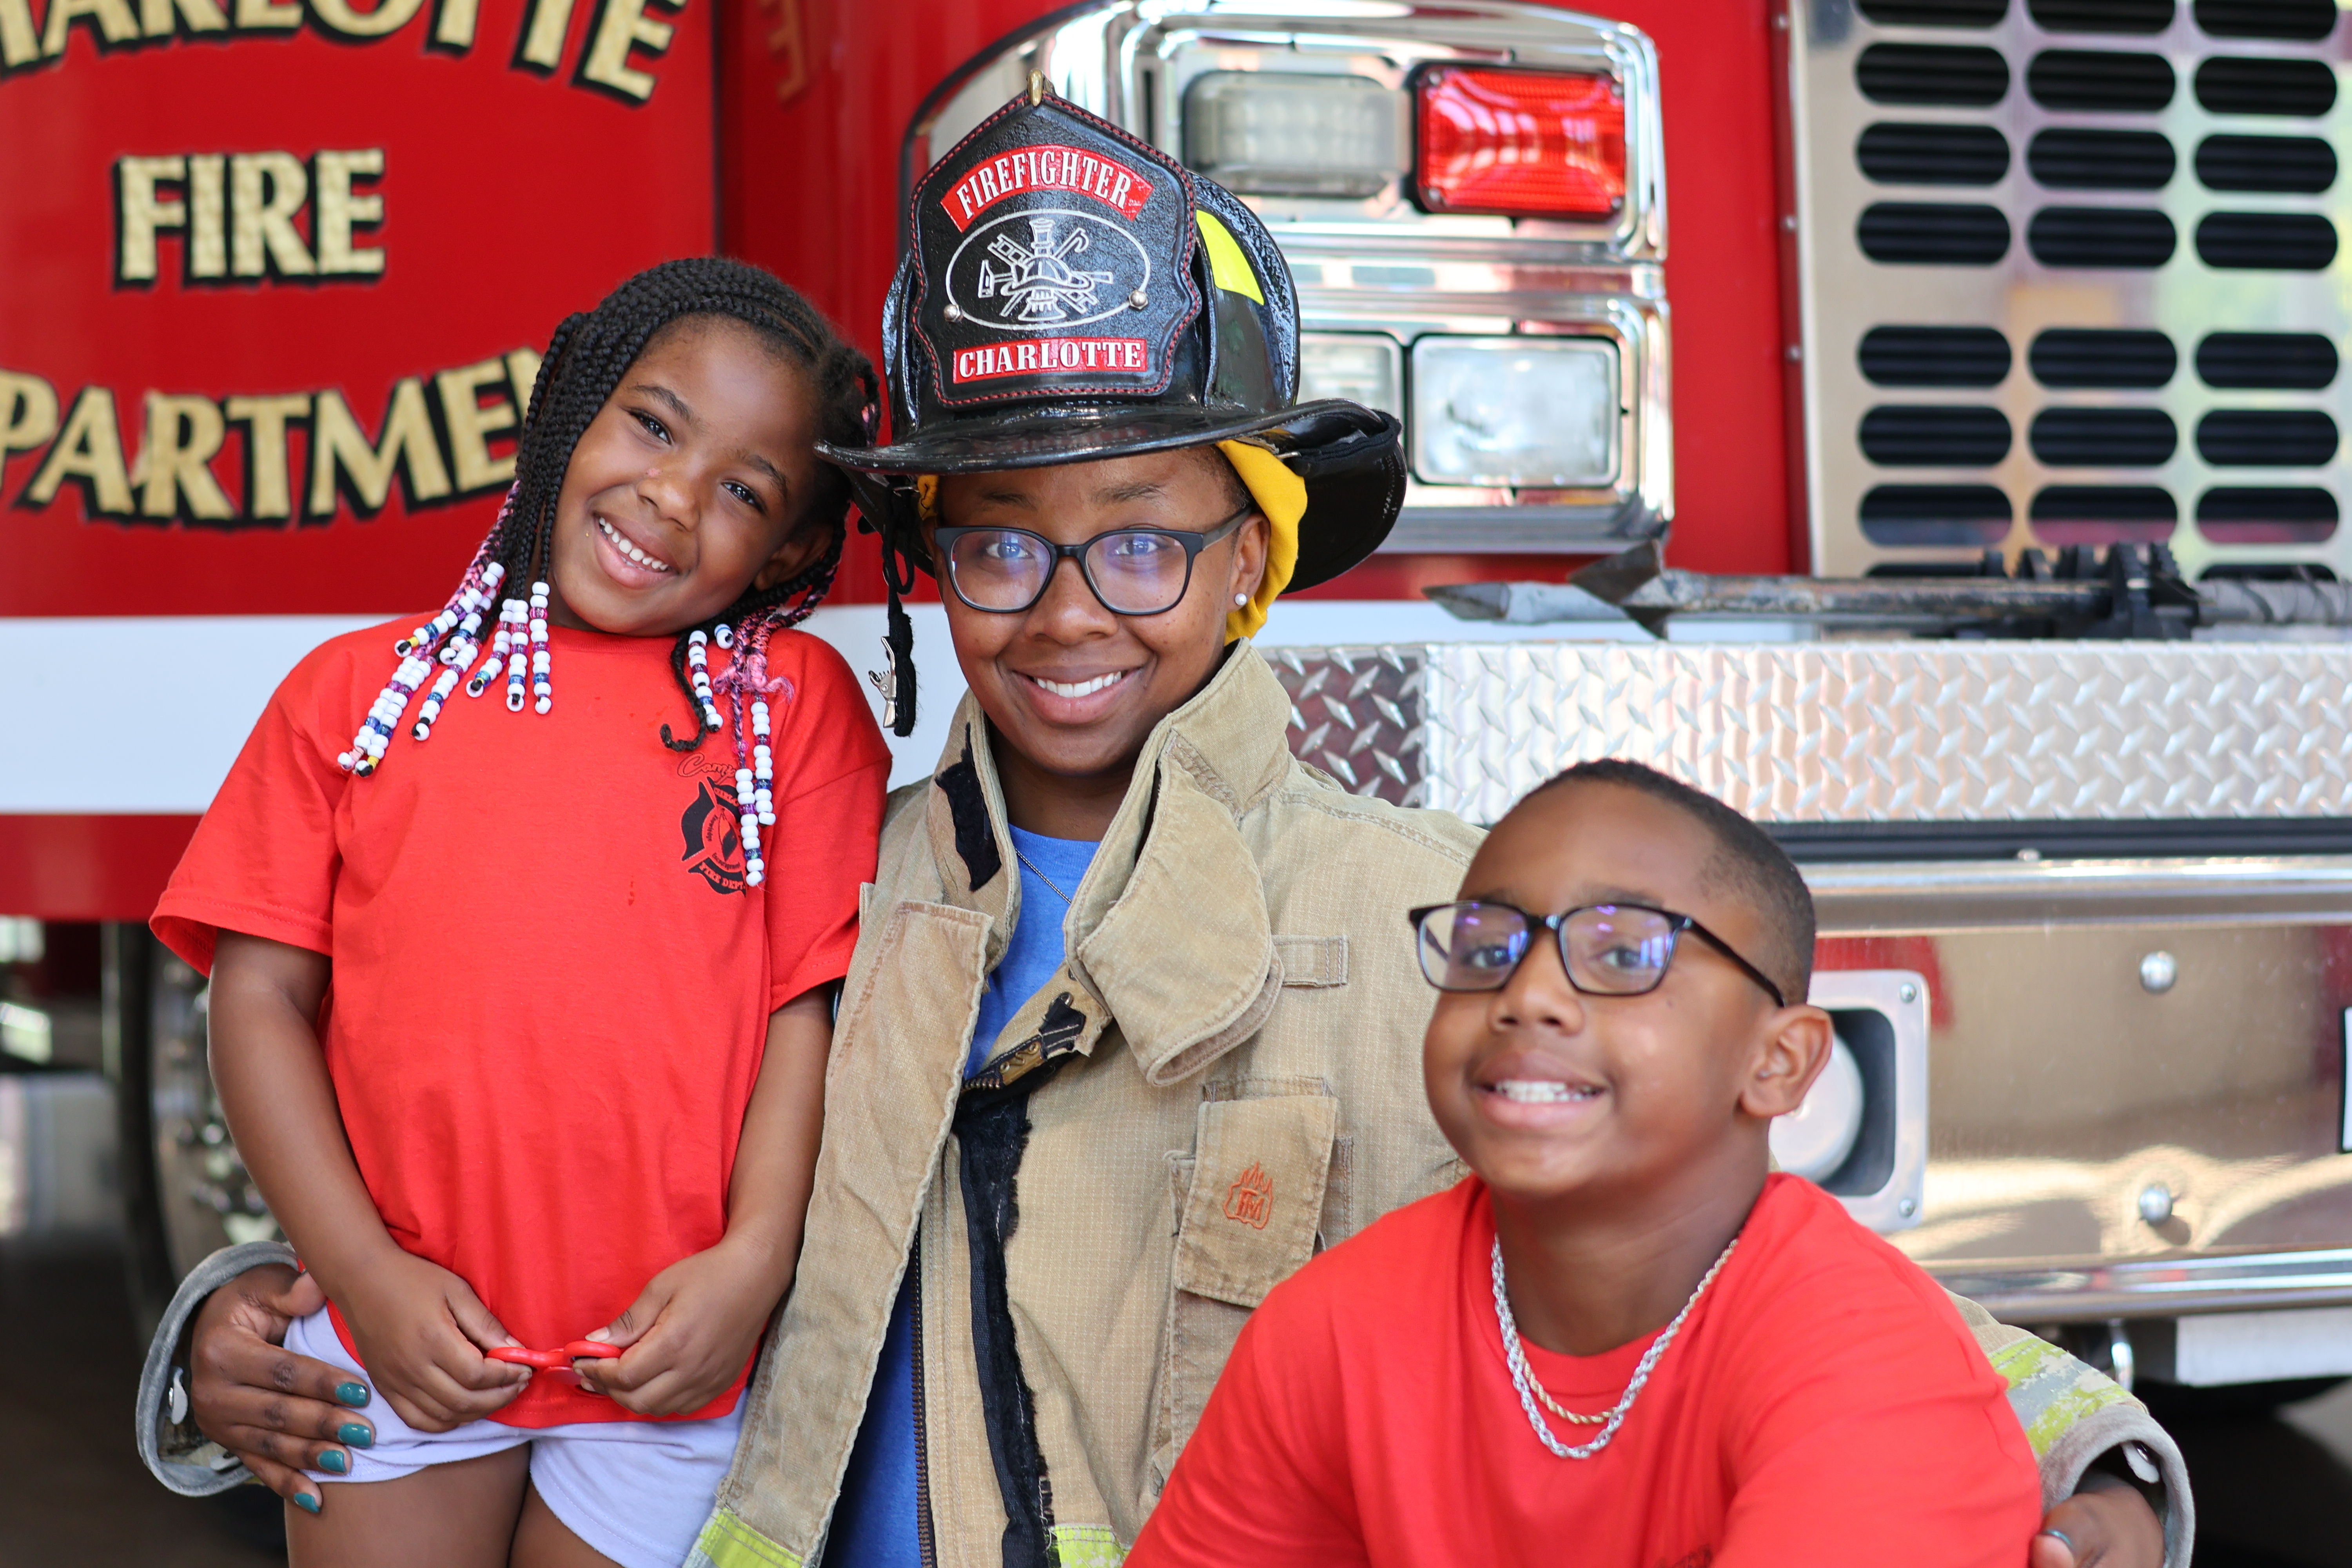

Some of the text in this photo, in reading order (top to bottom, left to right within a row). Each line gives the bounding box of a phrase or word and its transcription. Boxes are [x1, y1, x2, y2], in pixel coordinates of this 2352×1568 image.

[114, 147, 386, 289] FIRE
[956, 151, 1132, 220] FIREFIGHTER
[959, 340, 1142, 378] CHARLOTTE
